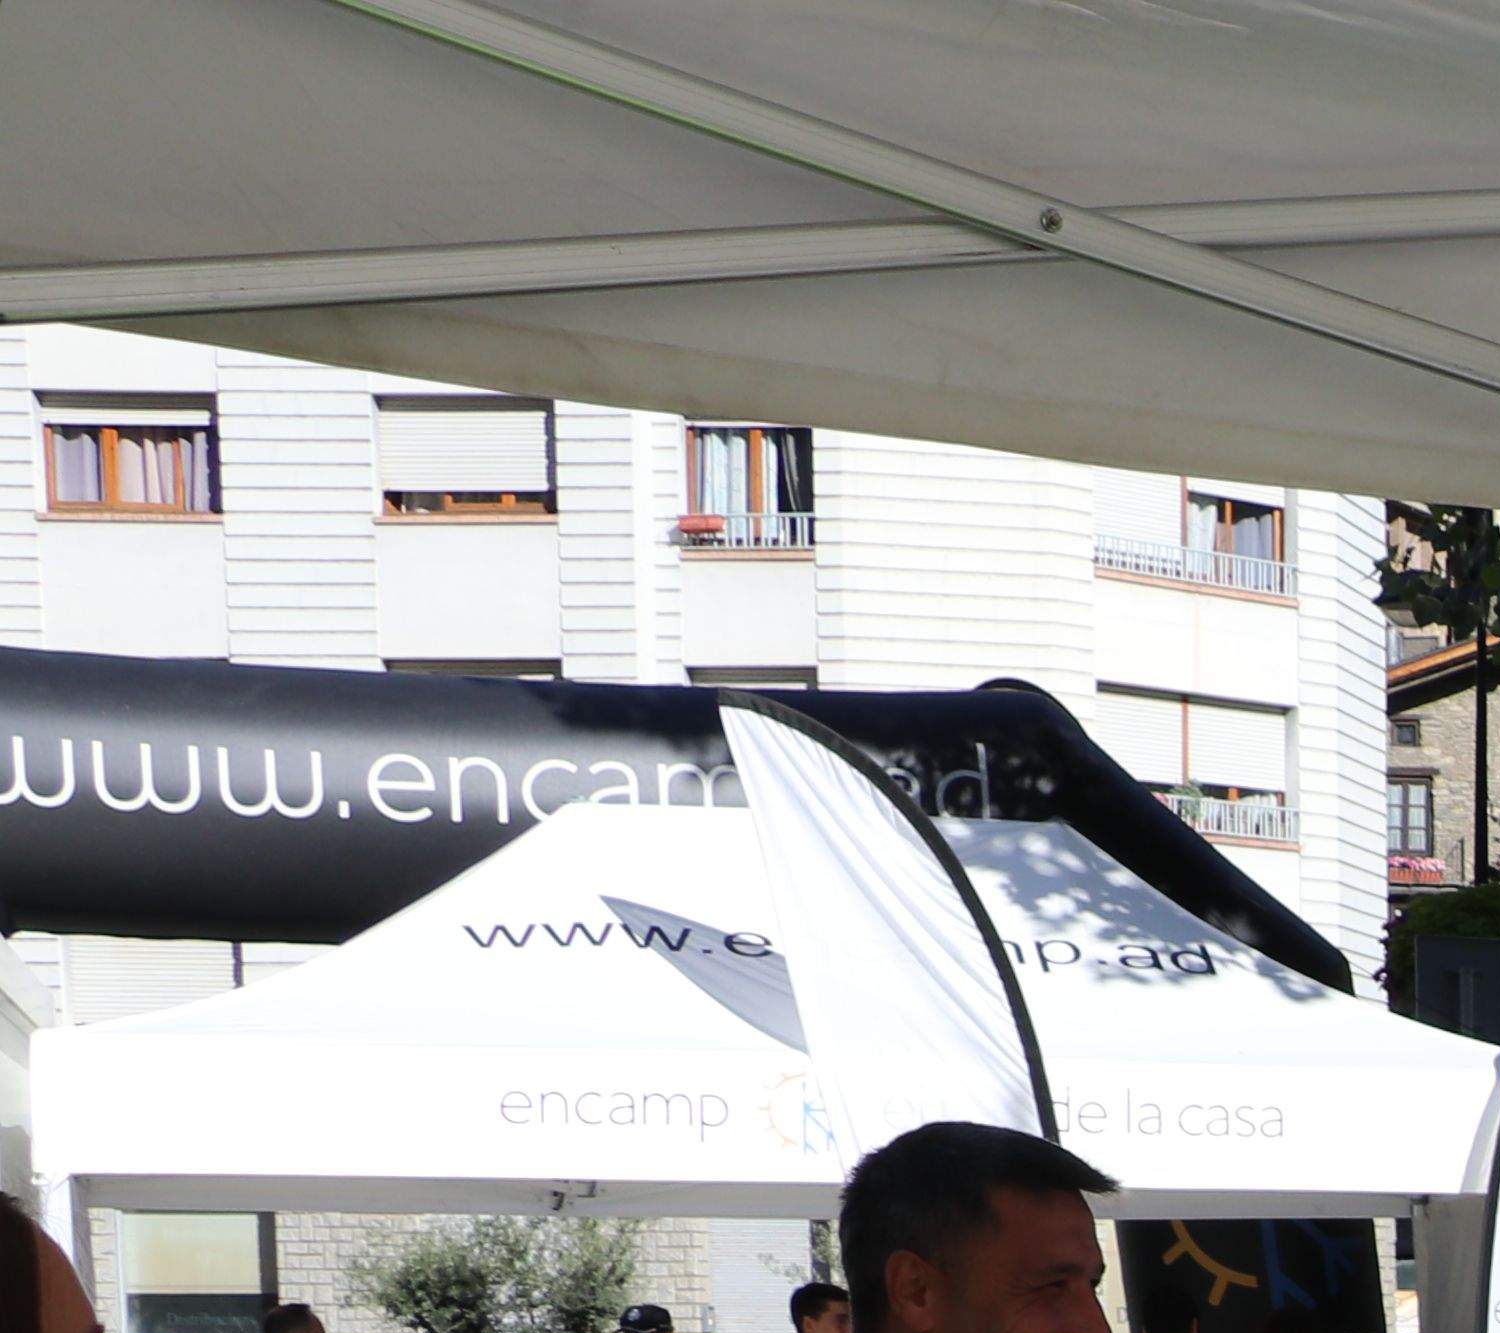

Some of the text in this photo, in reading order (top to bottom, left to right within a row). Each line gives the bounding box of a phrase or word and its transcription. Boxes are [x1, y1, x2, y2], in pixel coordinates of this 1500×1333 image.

[500, 1090, 729, 1142] encamp
[1126, 1087, 1162, 1135] la
[1178, 1103, 1284, 1138] casa
